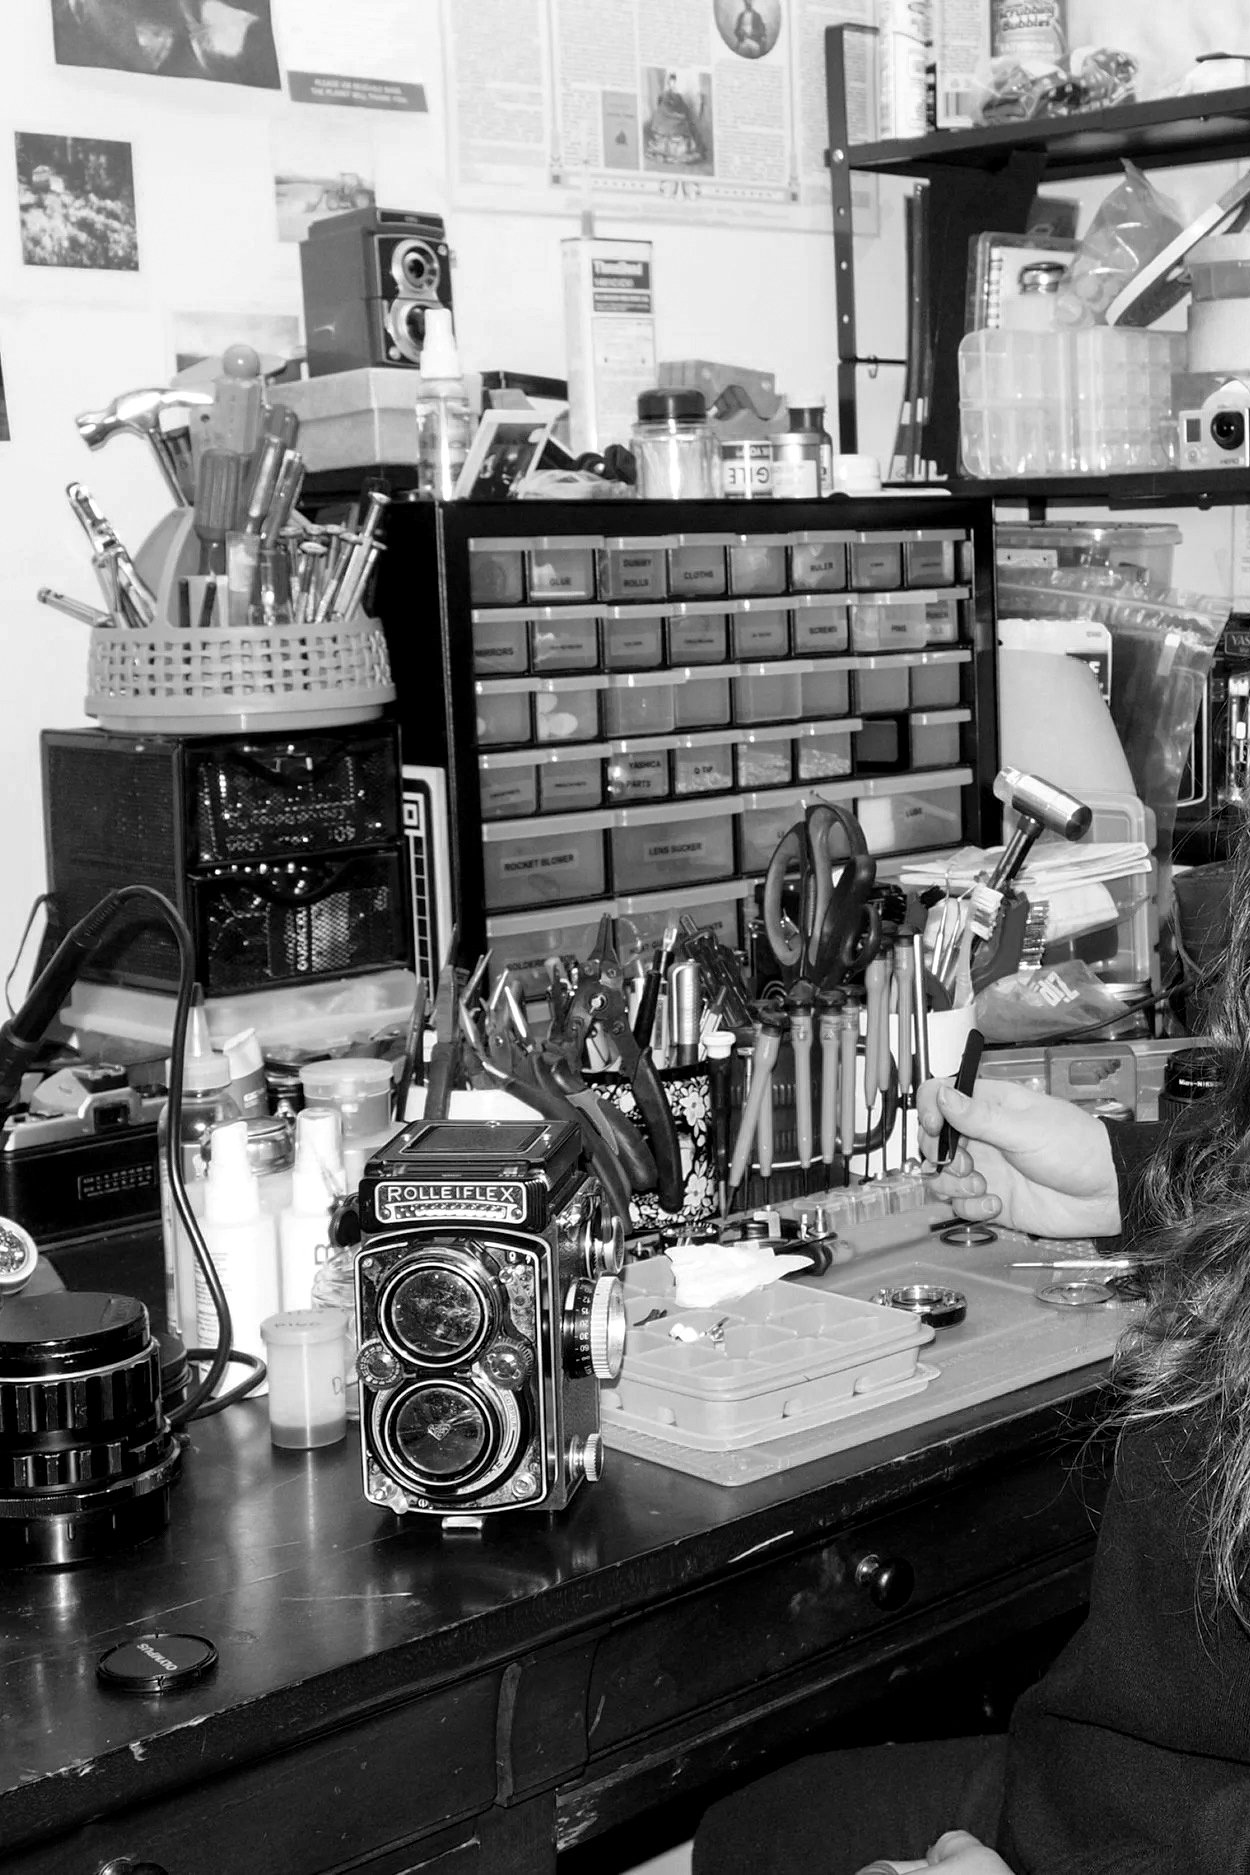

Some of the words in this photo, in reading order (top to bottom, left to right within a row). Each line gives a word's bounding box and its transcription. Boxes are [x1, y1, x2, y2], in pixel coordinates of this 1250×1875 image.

[810, 562, 833, 572] RULER
[684, 571, 714, 580] CLOTHS
[623, 579, 649, 587] ROLLS
[809, 626, 837, 635] SCREWS
[629, 761, 661, 769] YASHICA
[694, 767, 700, 775] Q
[648, 845, 669, 856] LENS
[671, 842, 702, 853] SUCKER
[503, 859, 538, 871] ROCKET
[541, 854, 574, 866] BLOWER
[387, 1187, 514, 1203] ROLLEIFLEX
[136, 1643, 178, 1671] OLYMPUS
